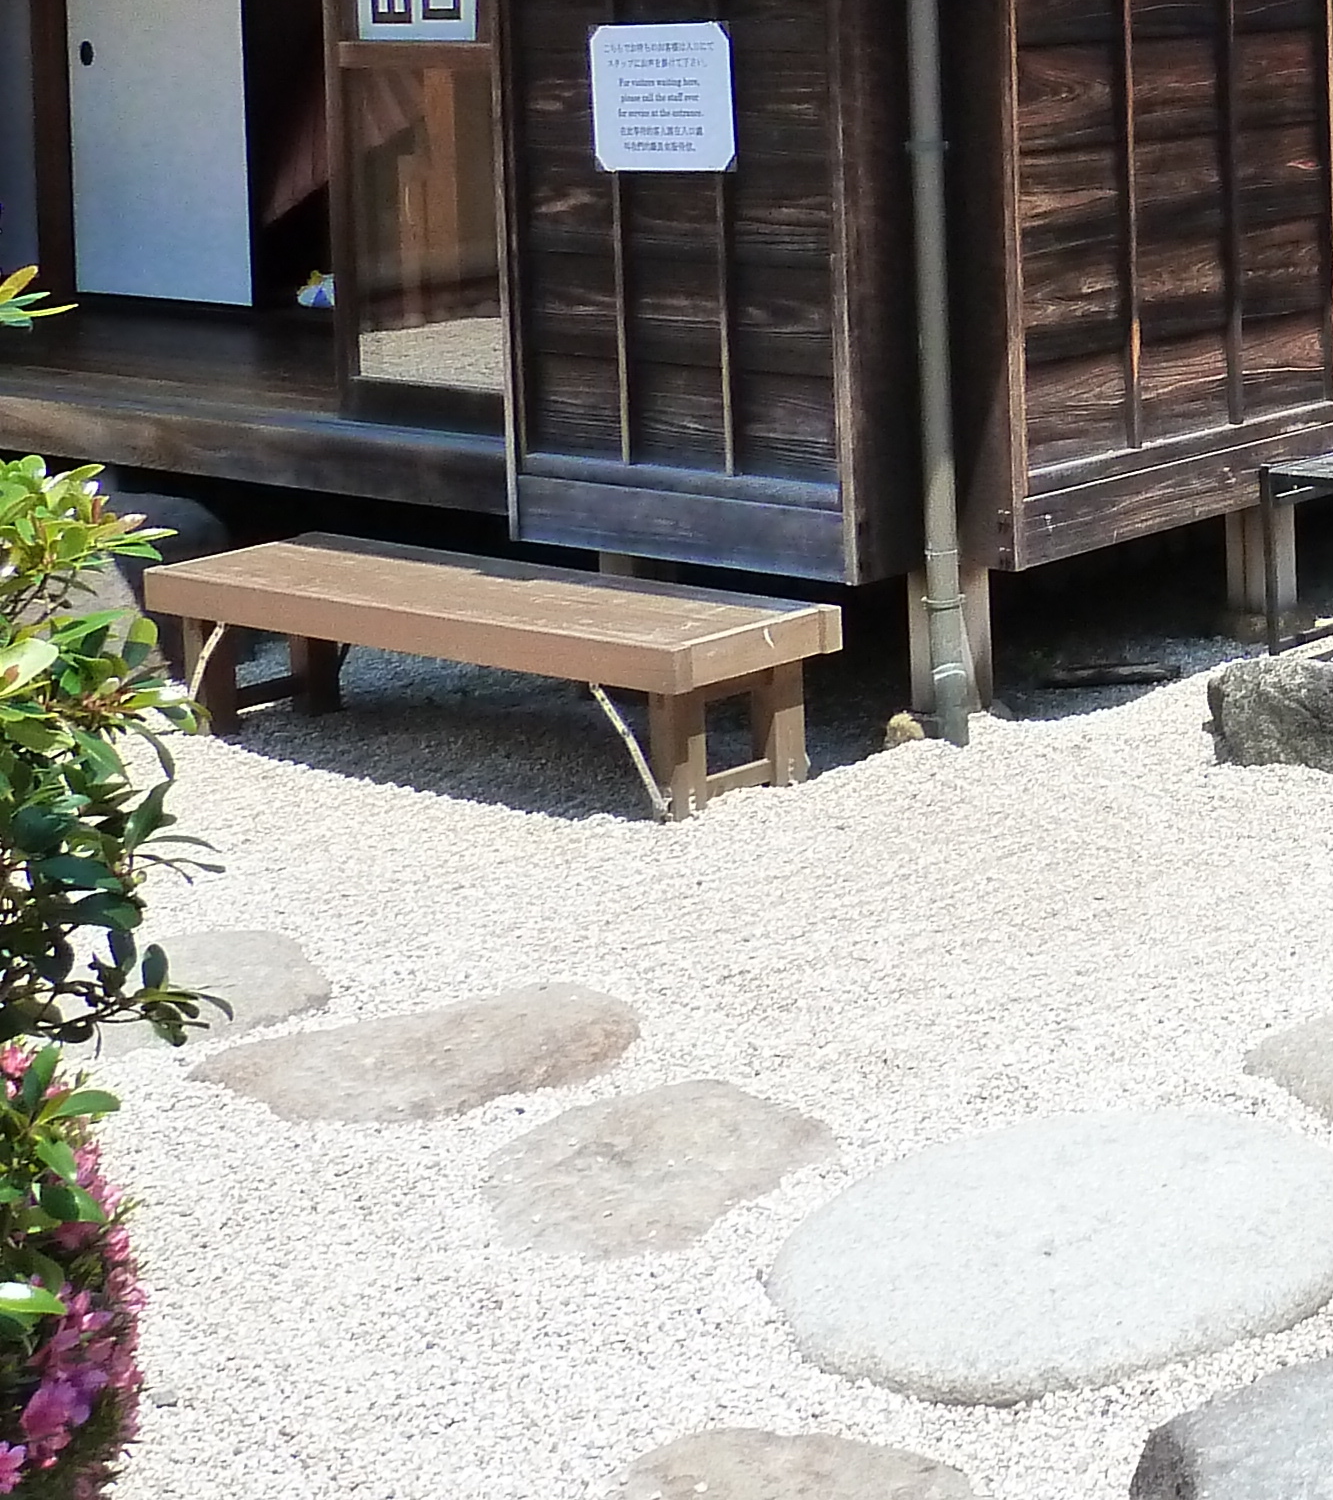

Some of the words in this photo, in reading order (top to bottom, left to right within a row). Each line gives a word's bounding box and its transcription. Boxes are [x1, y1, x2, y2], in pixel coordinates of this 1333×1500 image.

[619, 78, 629, 87] For
[657, 79, 681, 87] waiting
[621, 94, 640, 103] please
[642, 94, 654, 102] call
[655, 93, 666, 102] the
[667, 92, 683, 102] staff
[618, 108, 627, 117] for
[660, 109, 670, 117] the
